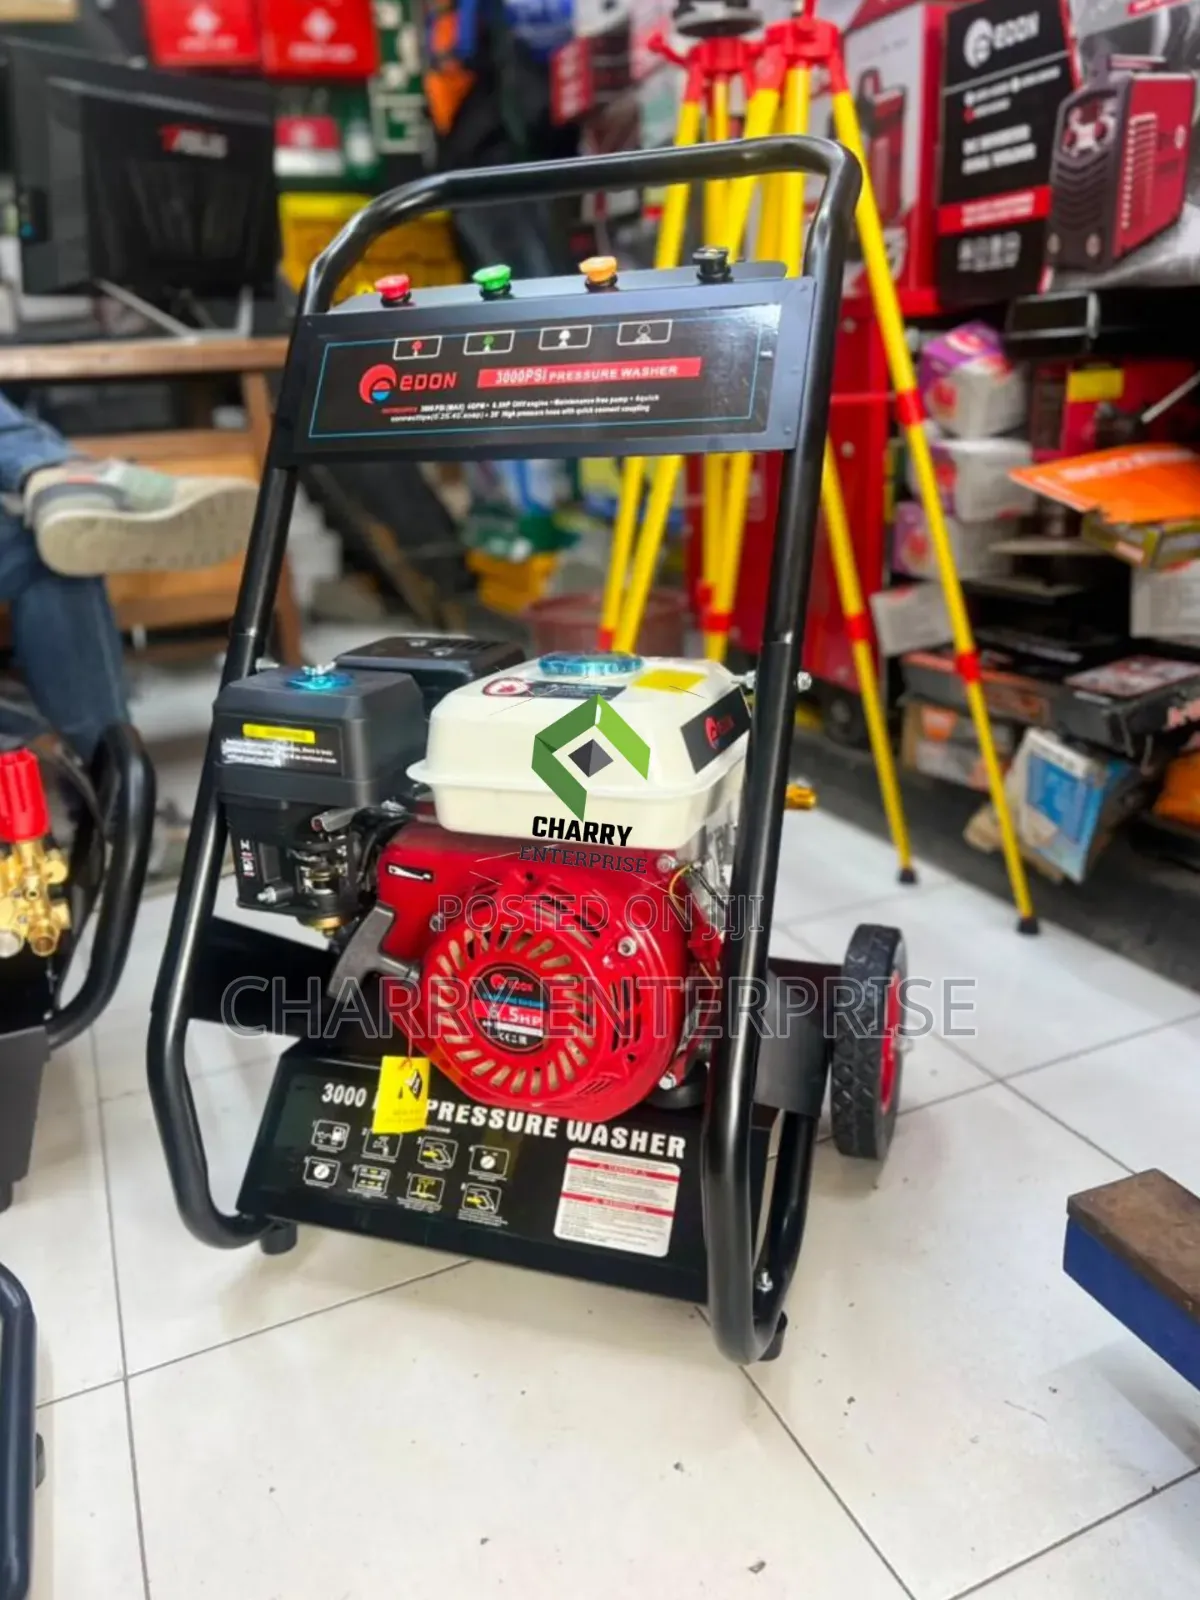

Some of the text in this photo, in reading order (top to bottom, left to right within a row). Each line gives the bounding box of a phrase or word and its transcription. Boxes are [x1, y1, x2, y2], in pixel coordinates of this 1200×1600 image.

[549, 368, 618, 382] PRESSURE
[621, 365, 679, 378] WASHER
[321, 1082, 367, 1108] 3000
[427, 1099, 559, 1139] PRESSURE
[566, 1119, 686, 1159] WASHER
